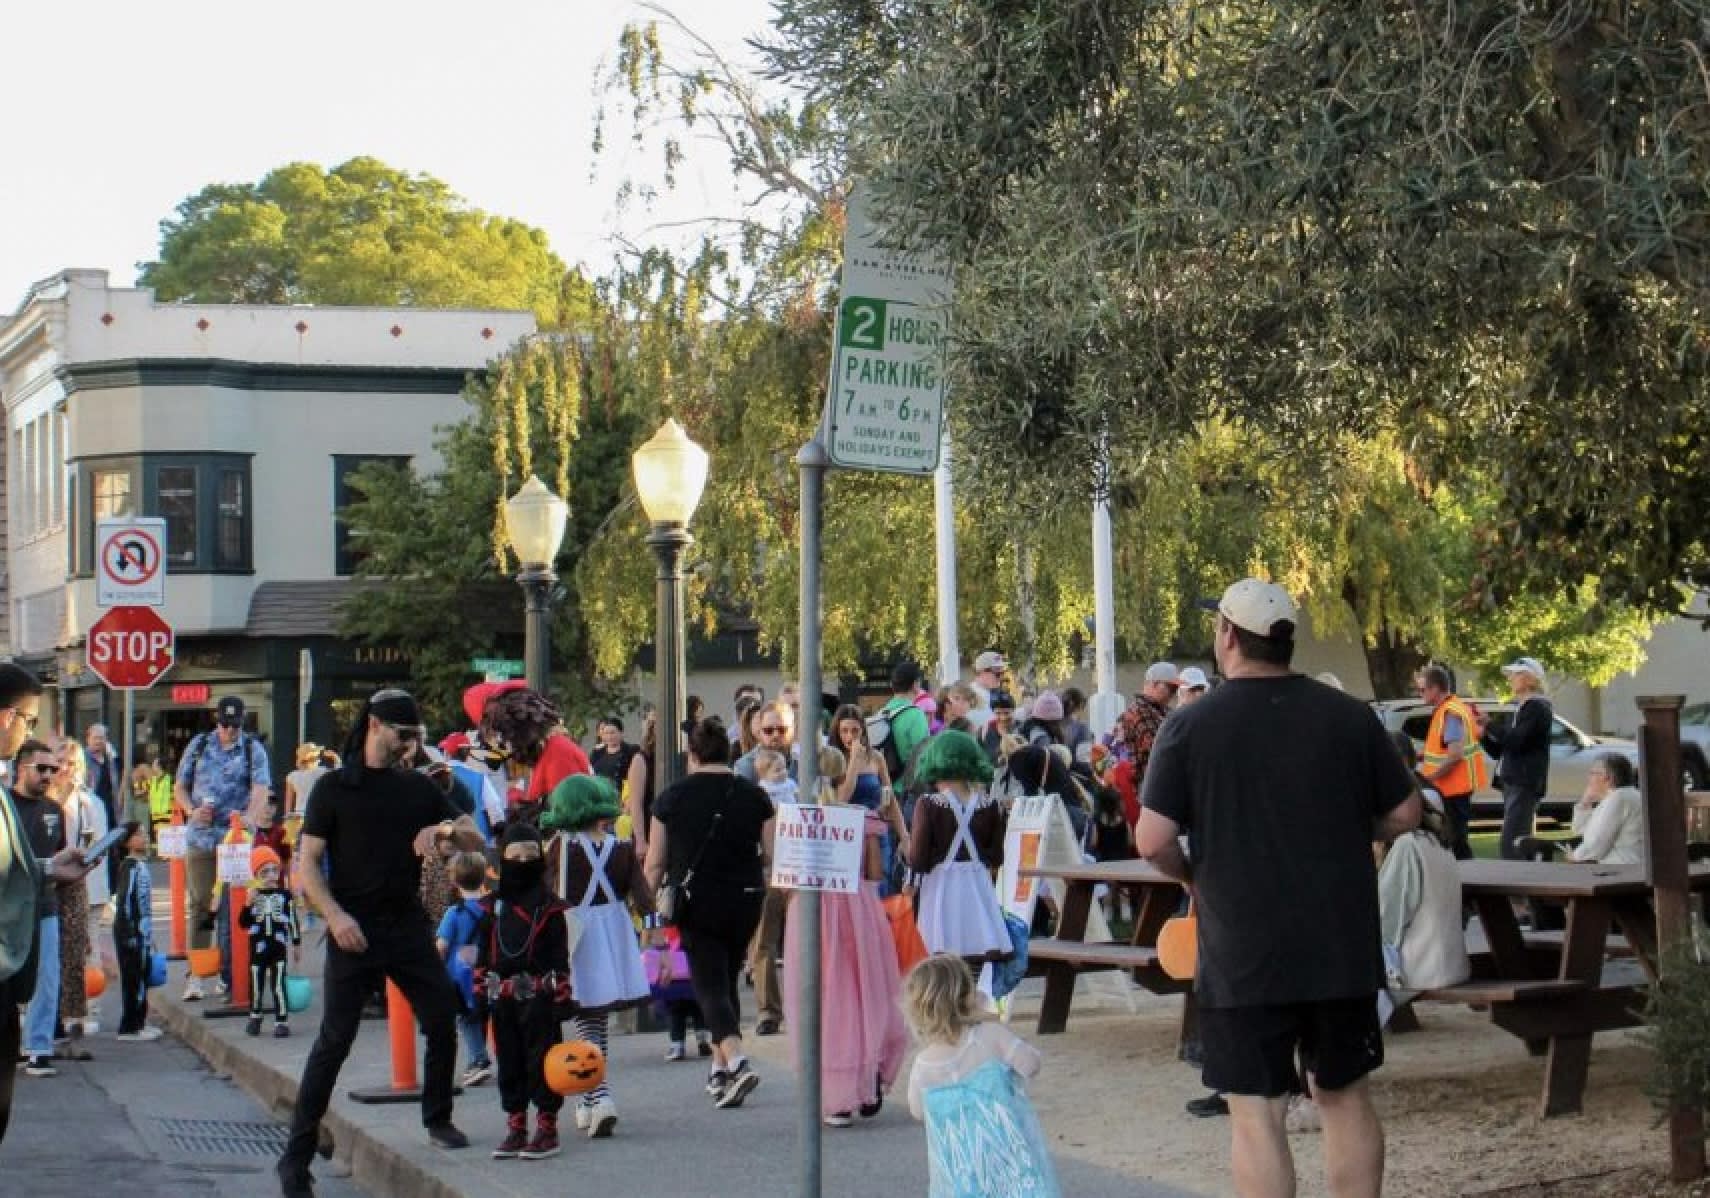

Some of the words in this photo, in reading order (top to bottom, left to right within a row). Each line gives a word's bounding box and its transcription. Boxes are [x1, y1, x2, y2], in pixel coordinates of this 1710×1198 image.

[853, 305, 876, 344] 2
[846, 355, 936, 391] PARKING
[843, 389, 857, 417] 7
[883, 399, 896, 411] TO
[898, 395, 911, 421] 6
[854, 426, 896, 441] SUNDAY
[898, 431, 921, 443] AND
[837, 440, 891, 457] HOLIDAYS
[894, 447, 935, 460] EXEMPT
[94, 632, 167, 662] STOP
[801, 807, 825, 824] NO
[779, 822, 855, 842] PARKING
